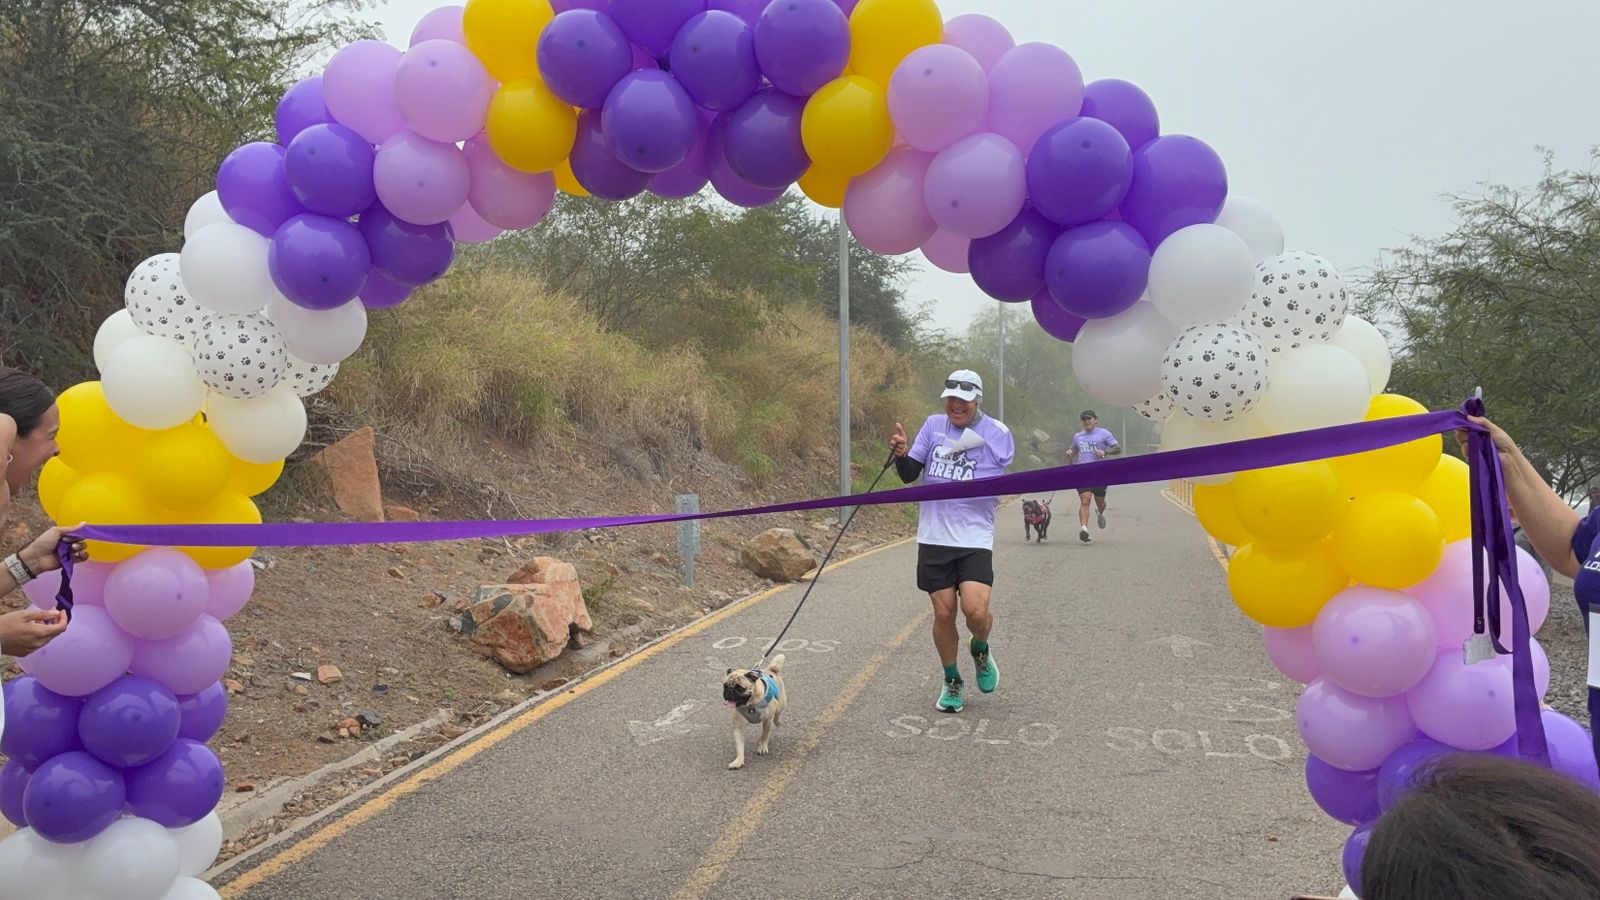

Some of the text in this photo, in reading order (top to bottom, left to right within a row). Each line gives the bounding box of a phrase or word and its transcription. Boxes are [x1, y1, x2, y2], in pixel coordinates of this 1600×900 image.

[711, 636, 843, 653] SOLO
[886, 714, 1060, 748] SOLO
[1106, 726, 1292, 760] SOLO
